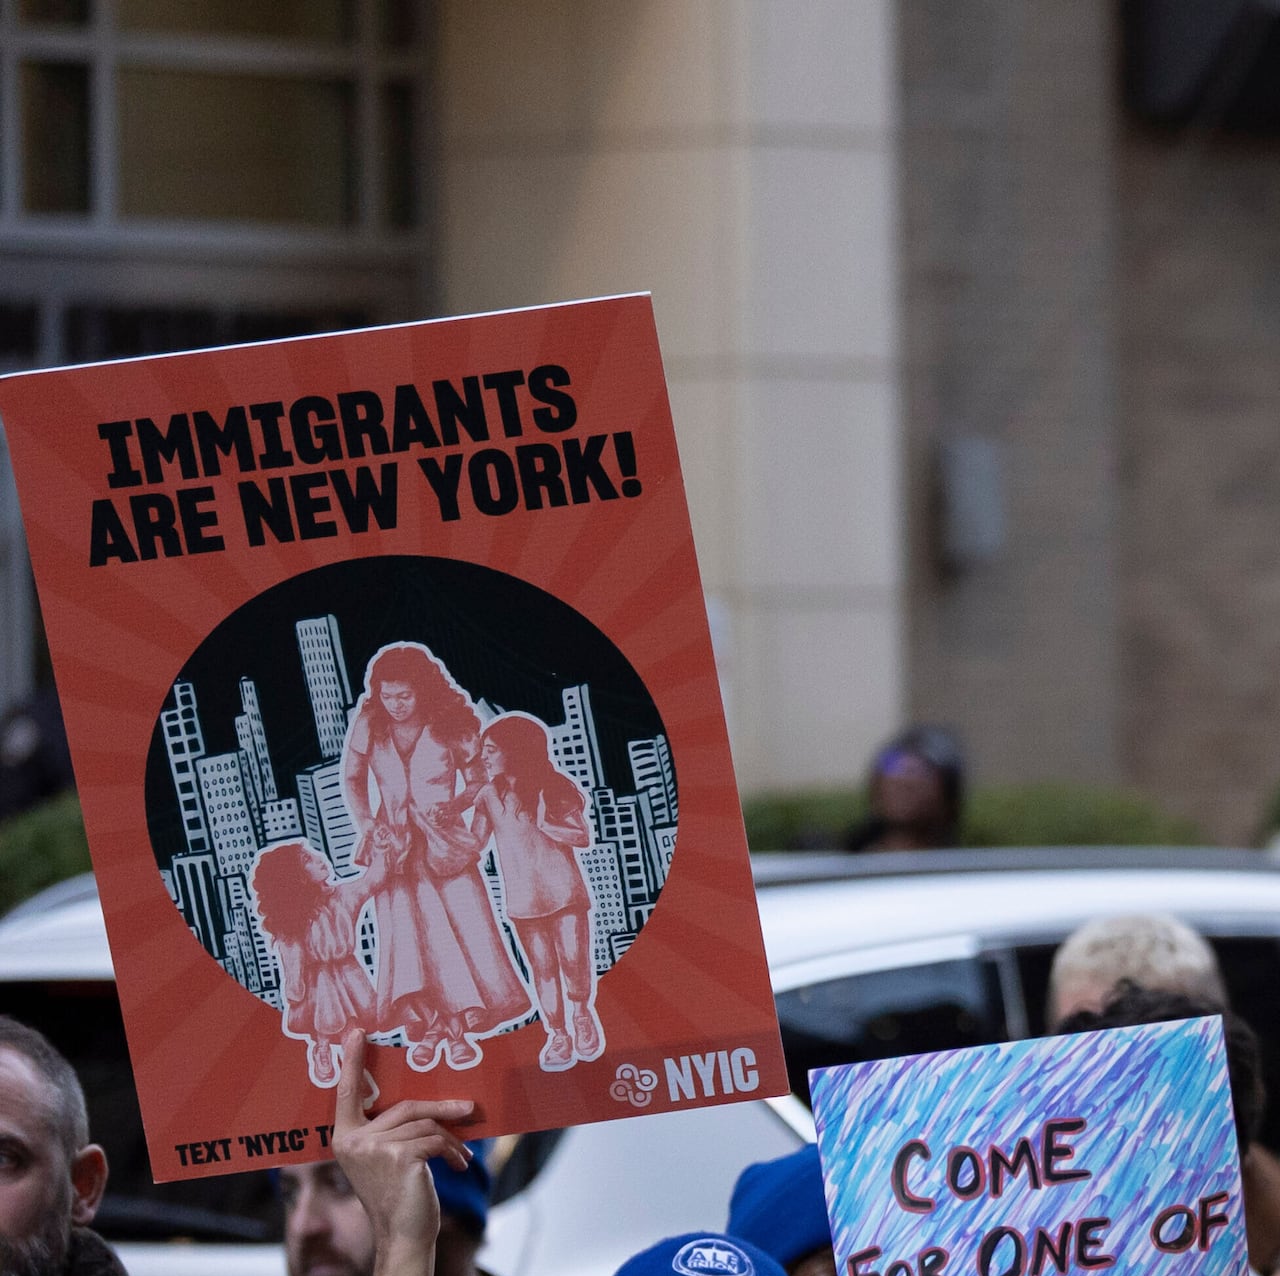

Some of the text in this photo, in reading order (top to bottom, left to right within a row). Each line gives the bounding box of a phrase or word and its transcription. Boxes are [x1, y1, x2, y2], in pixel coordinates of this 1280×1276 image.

[97, 364, 578, 489] IMMIGRANTS
[89, 431, 643, 567] ARE NEW YORK!
[664, 1047, 760, 1102] NYIC
[175, 1138, 232, 1167] TEXT
[238, 1128, 309, 1157] 'NYIC'
[891, 1117, 1092, 1215] COME
[1150, 1191, 1231, 1253] OF
